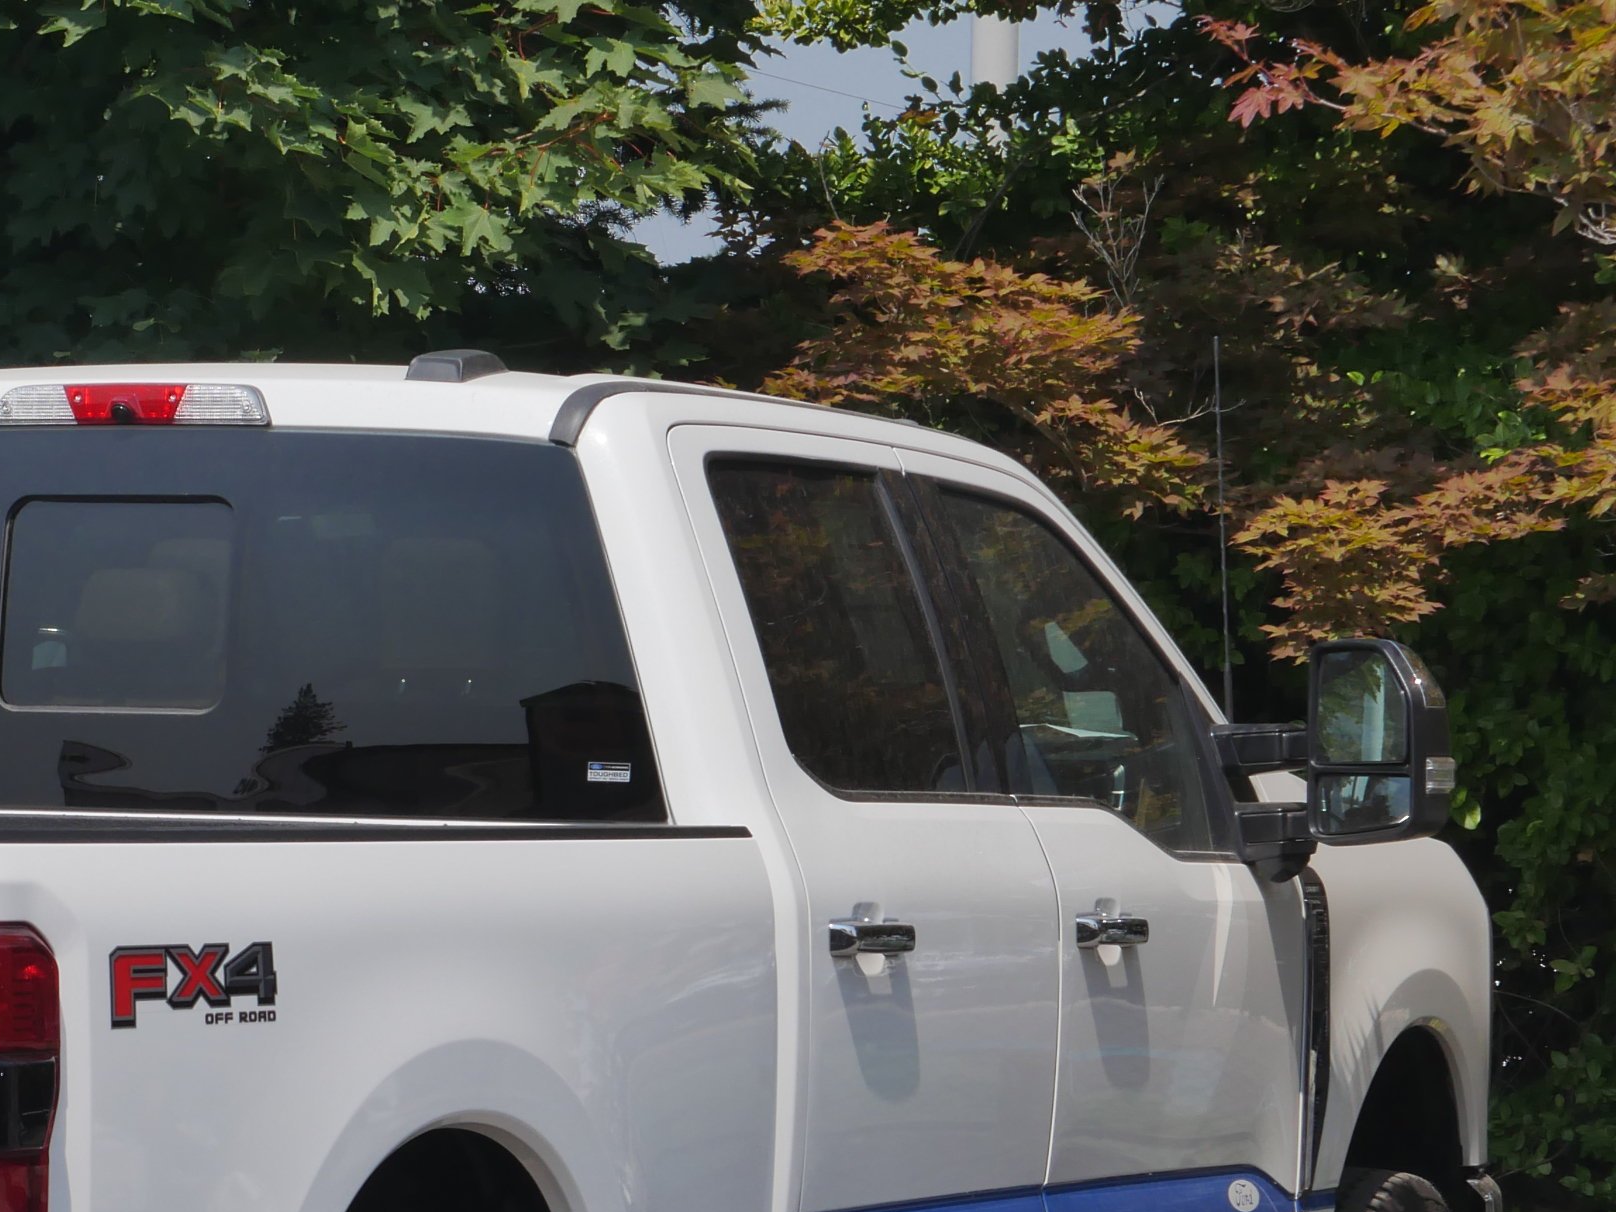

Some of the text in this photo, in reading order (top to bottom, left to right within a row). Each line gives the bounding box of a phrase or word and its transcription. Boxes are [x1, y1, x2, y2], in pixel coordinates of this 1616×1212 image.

[109, 941, 278, 1030] FX4
[205, 1010, 277, 1025] OFF ROAD
